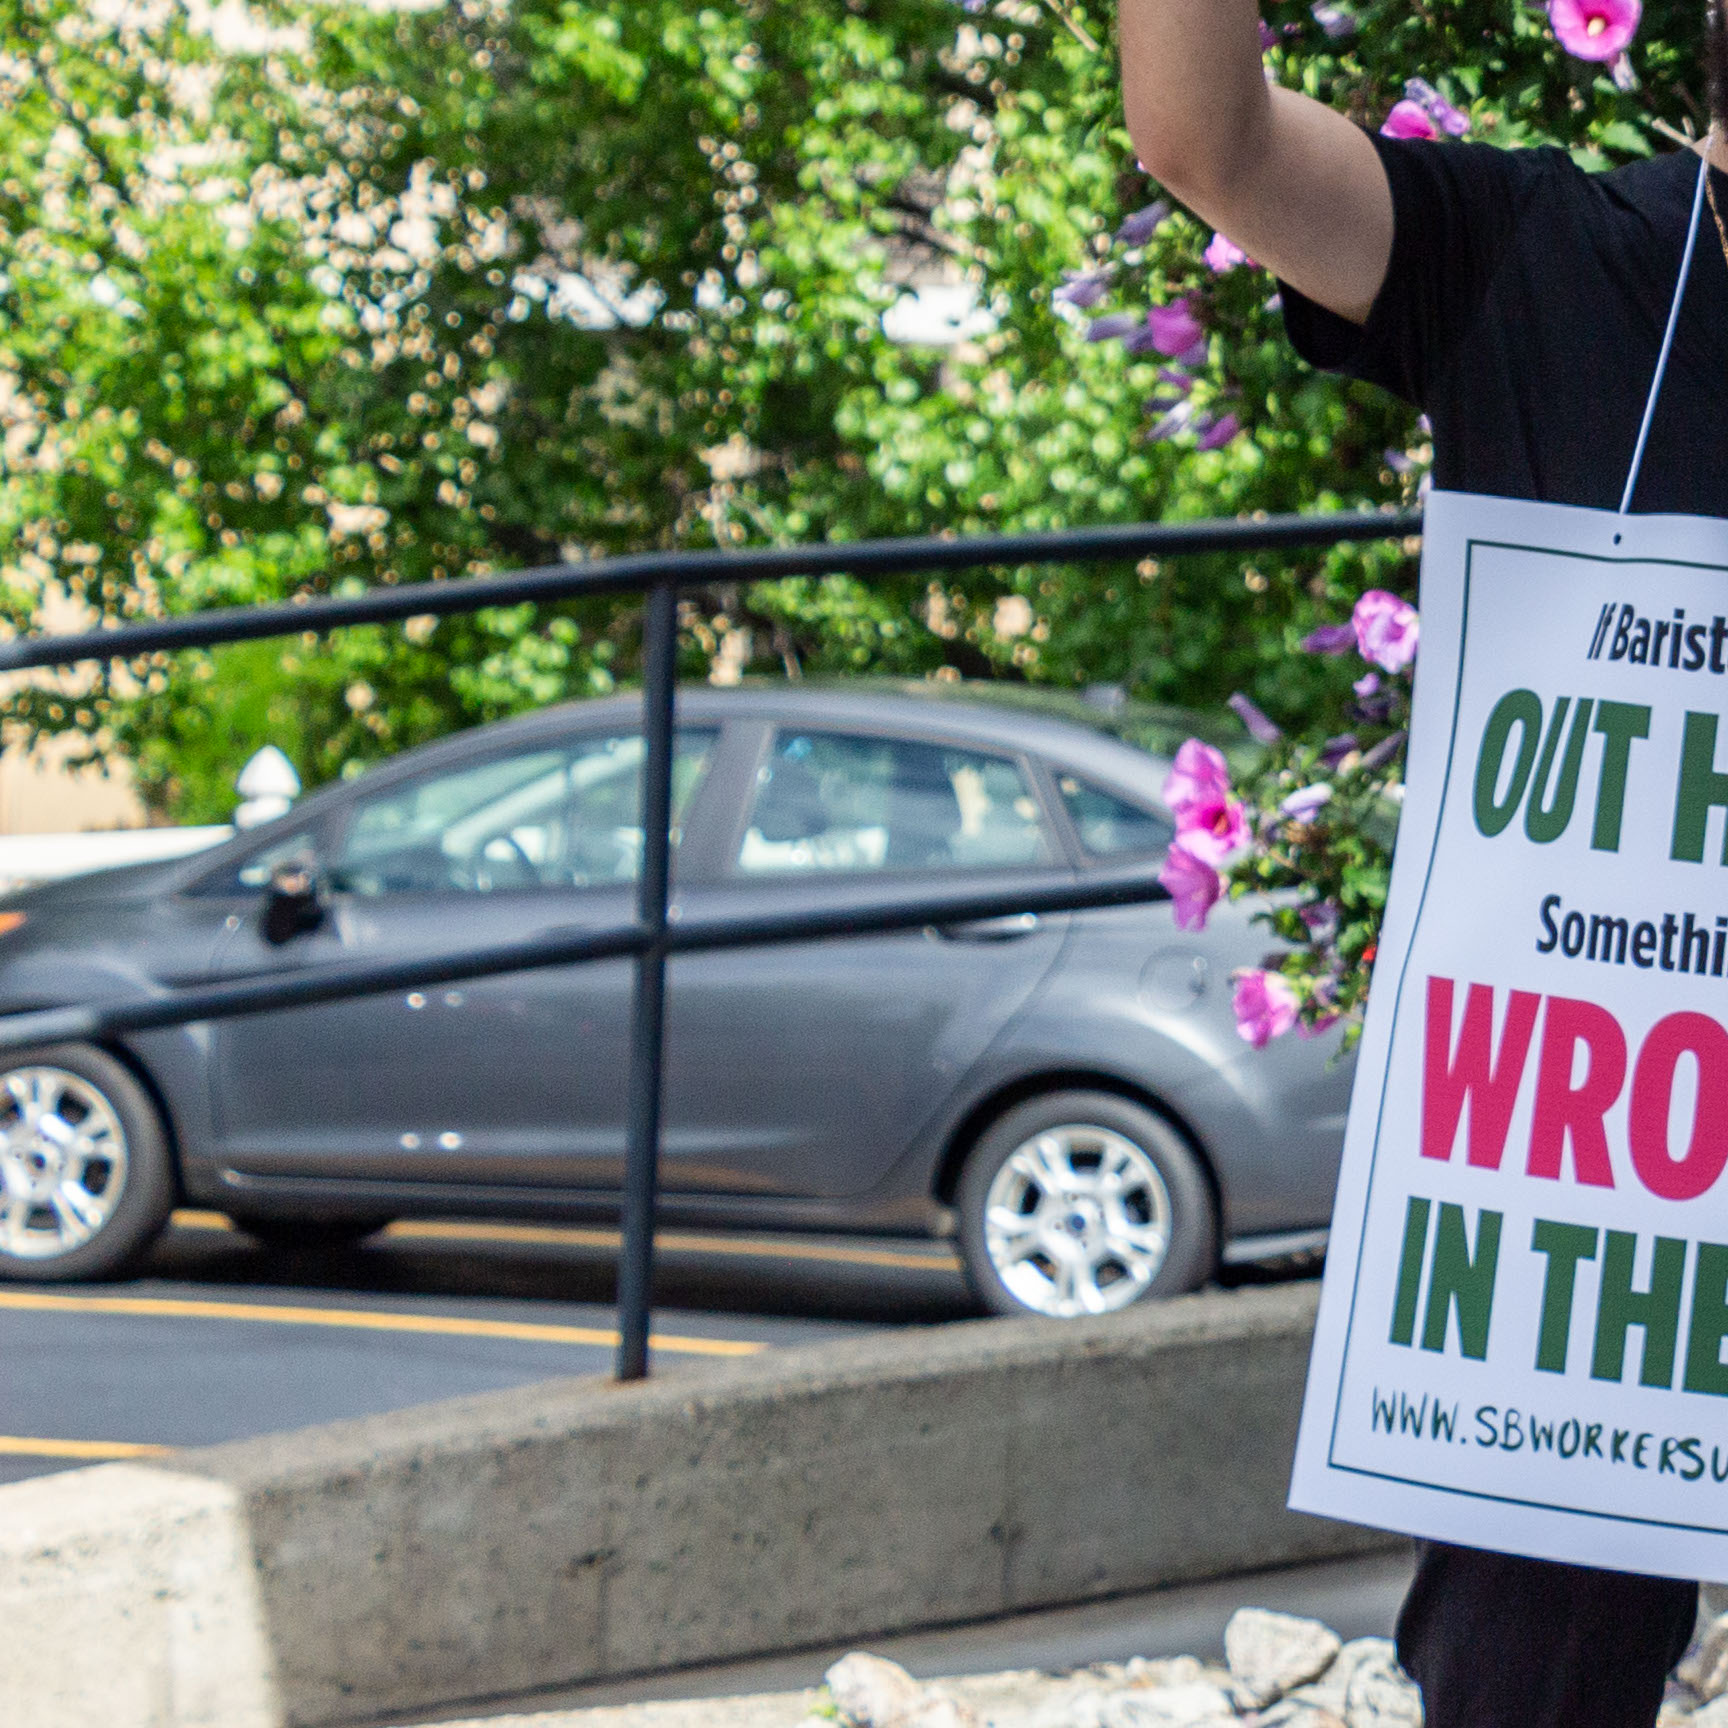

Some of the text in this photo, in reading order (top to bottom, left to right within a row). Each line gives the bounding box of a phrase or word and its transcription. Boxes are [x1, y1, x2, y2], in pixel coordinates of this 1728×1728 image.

[1587, 602, 1617, 660] If
[1472, 688, 1653, 853] OUT
[1388, 1195, 1504, 1362] IN
